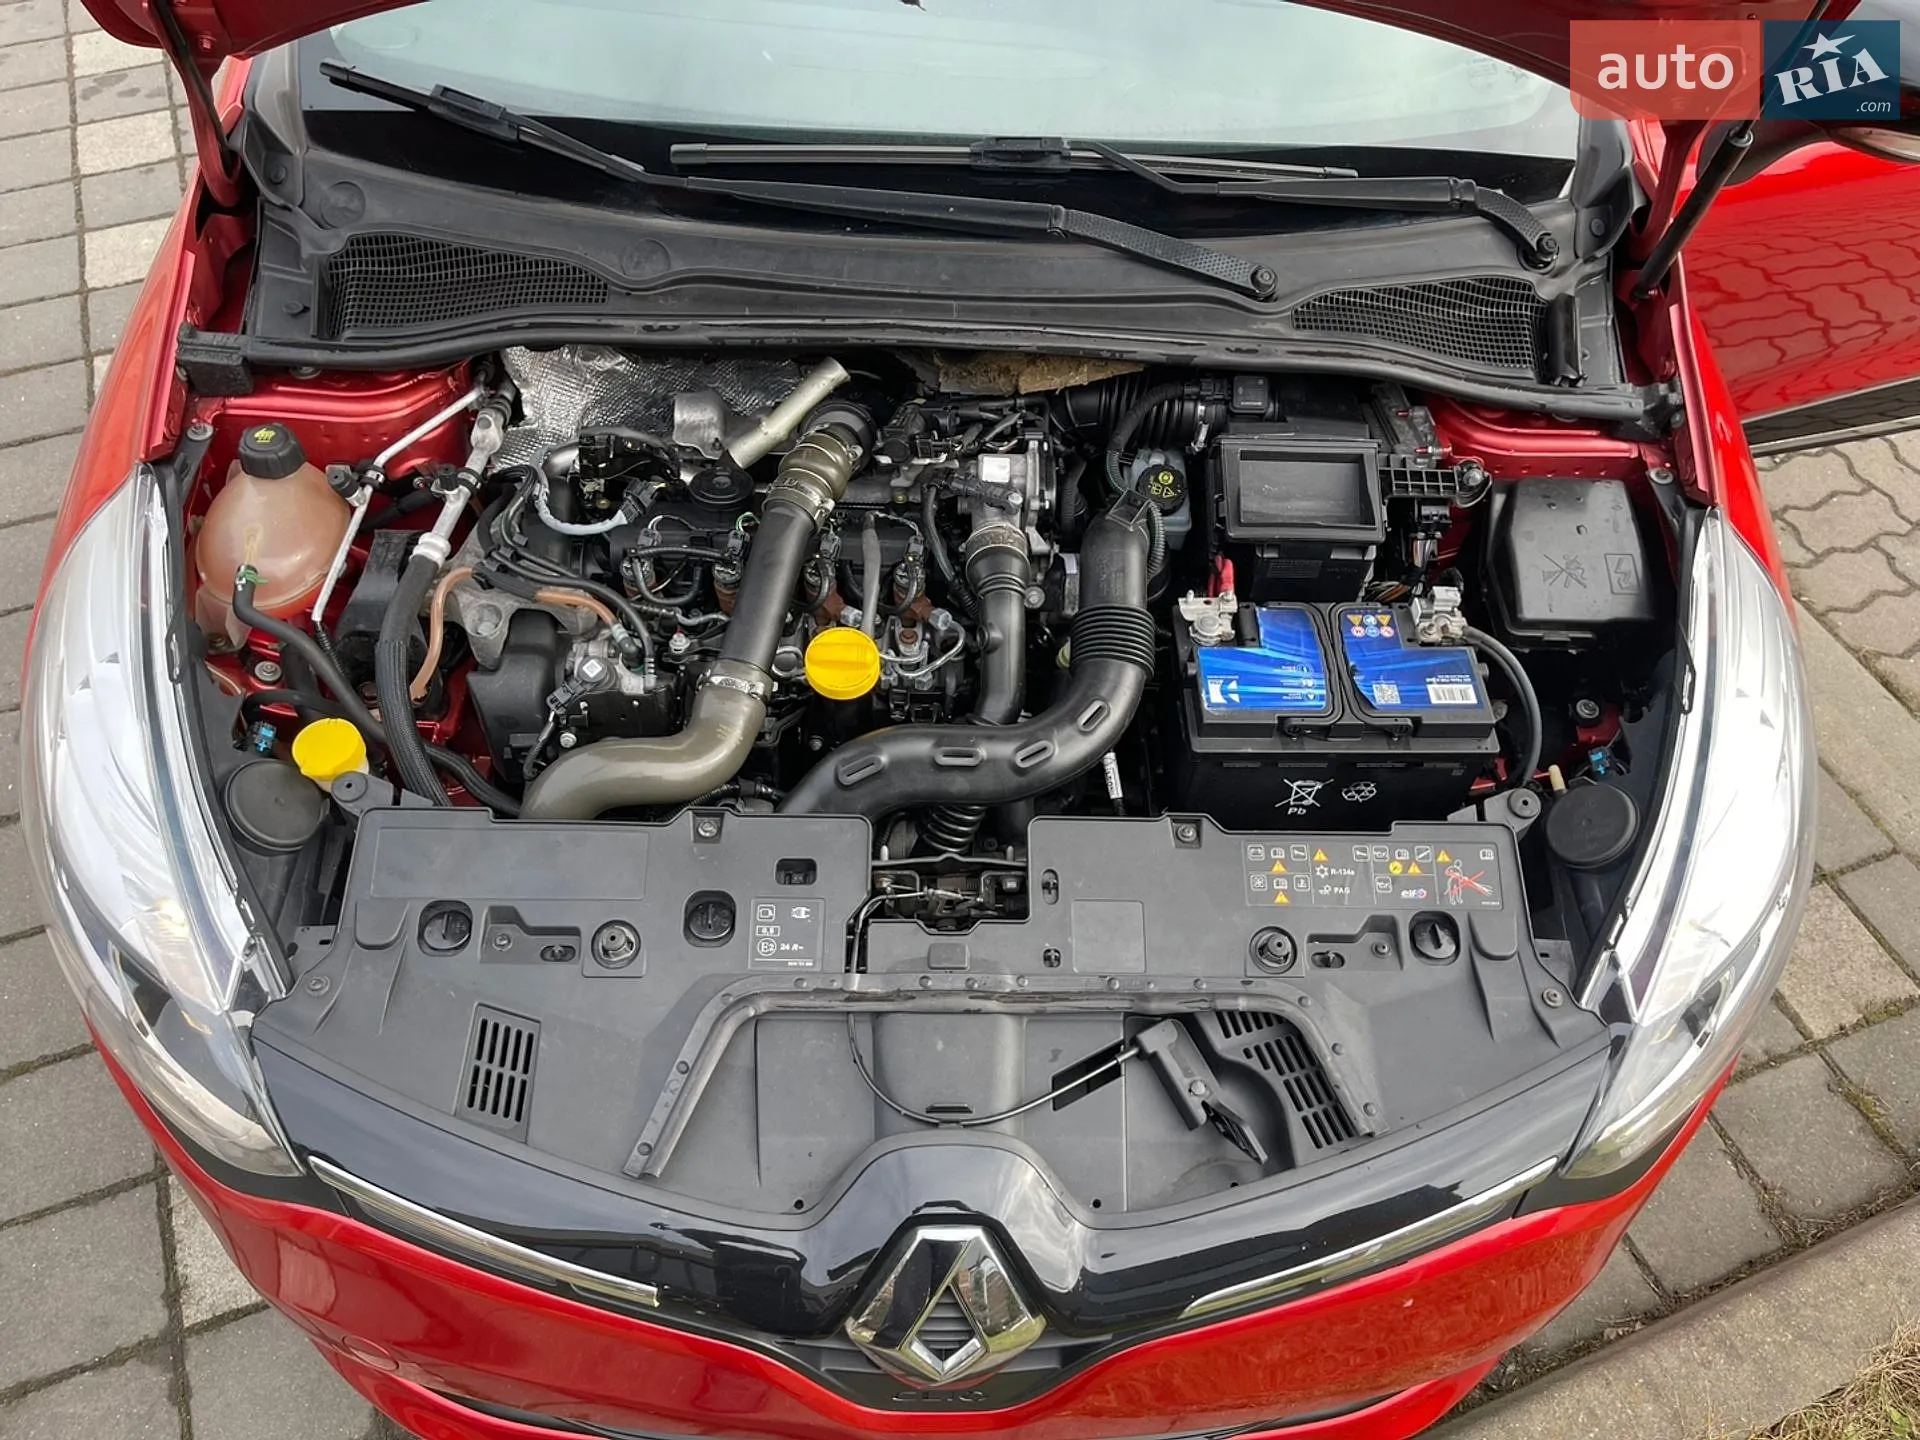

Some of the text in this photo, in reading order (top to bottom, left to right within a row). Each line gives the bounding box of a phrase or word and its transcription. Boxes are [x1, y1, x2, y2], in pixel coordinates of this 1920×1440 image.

[1286, 806, 1307, 815] Pb
[1333, 886, 1351, 895] PAG
[1400, 889, 1419, 899] elf
